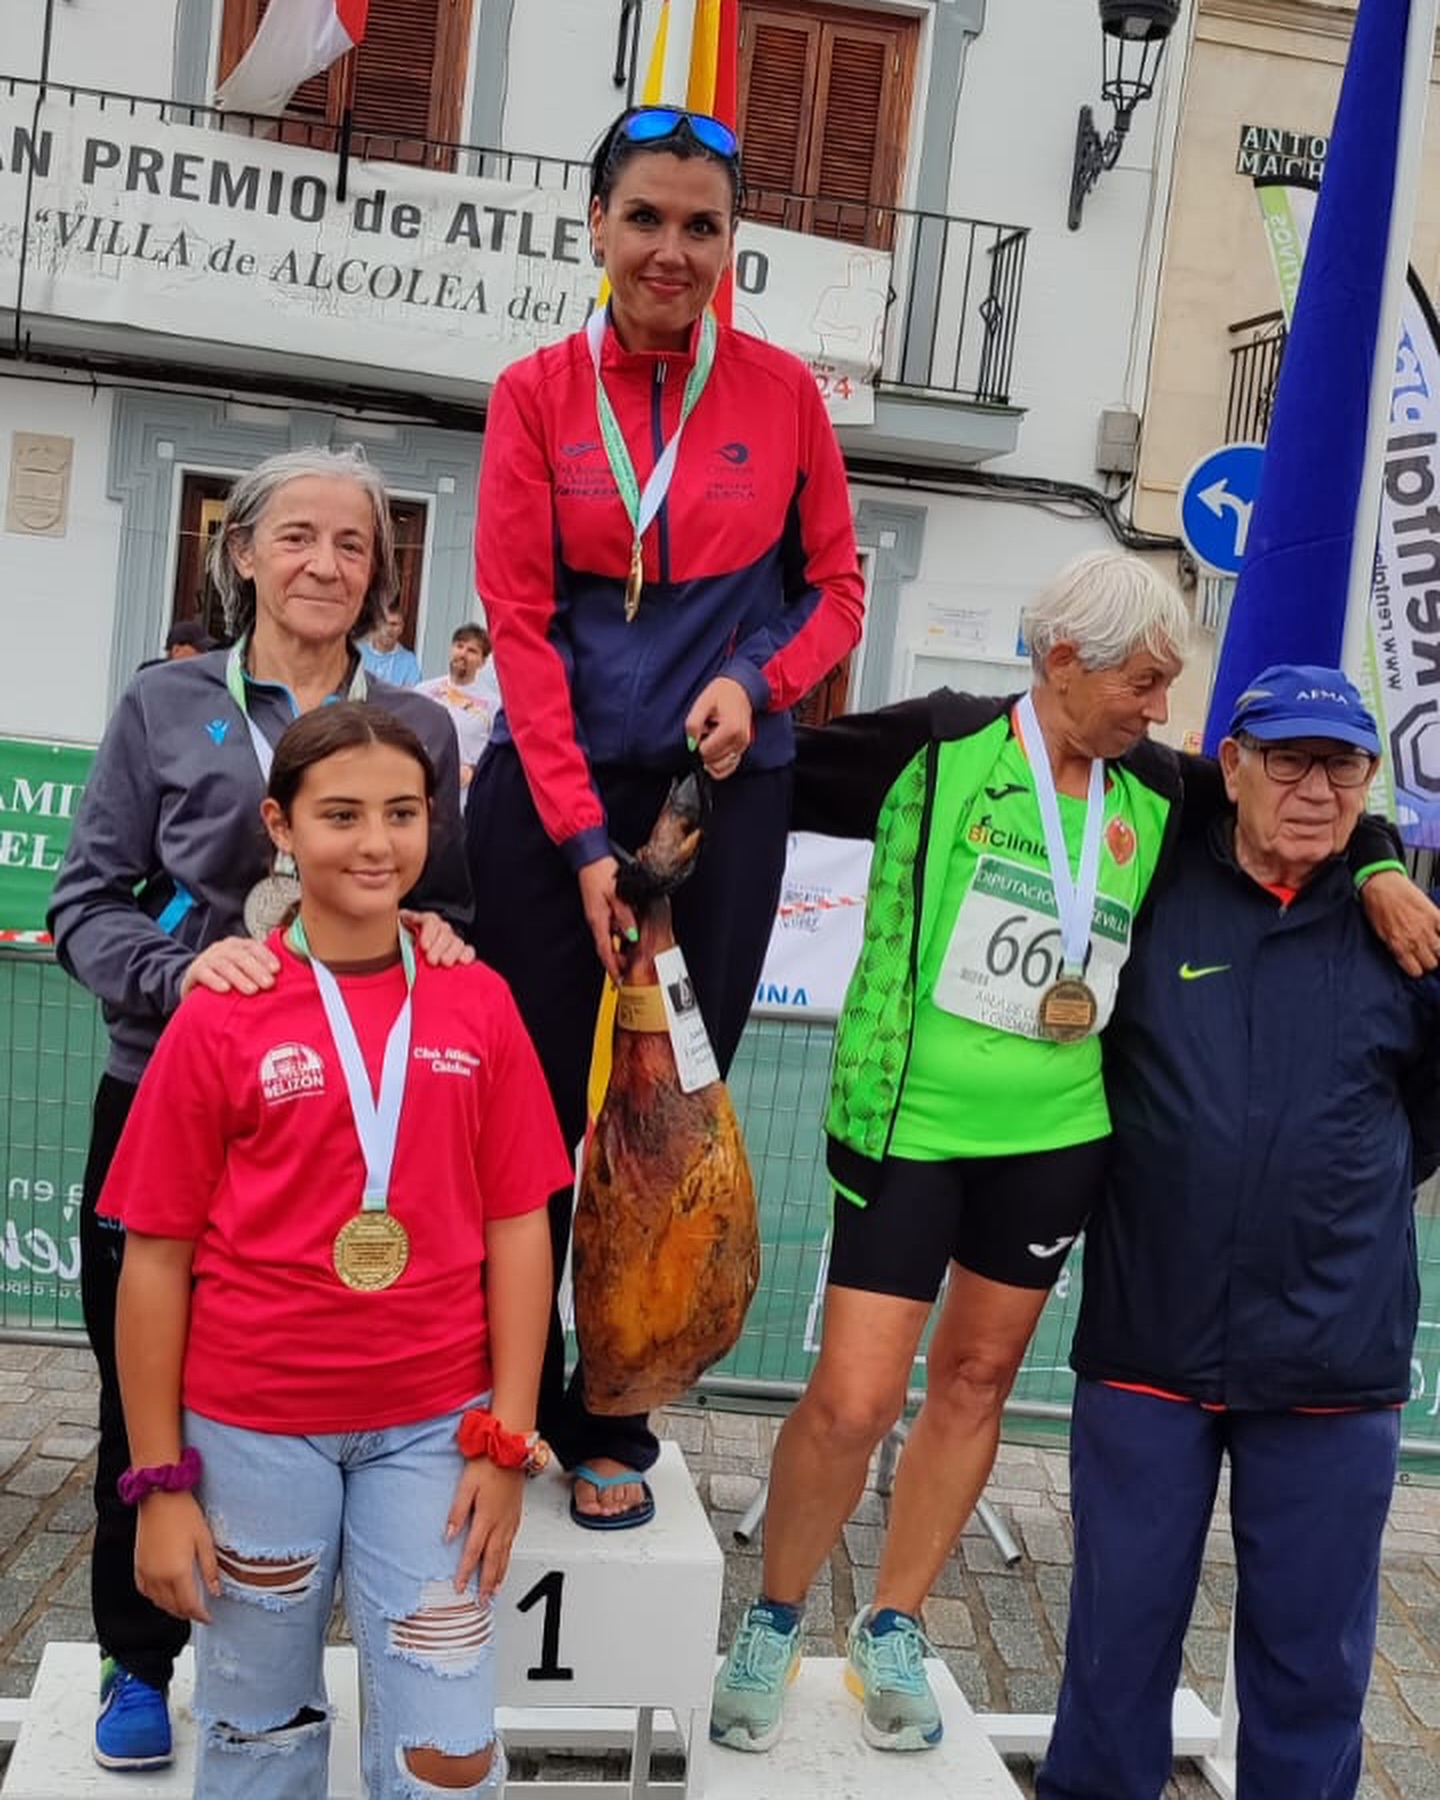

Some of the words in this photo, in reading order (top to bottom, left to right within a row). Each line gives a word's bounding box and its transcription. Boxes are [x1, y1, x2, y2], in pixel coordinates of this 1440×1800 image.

[82, 138, 327, 223] PREMIO
[352, 189, 423, 240] de
[207, 238, 256, 275] de
[269, 249, 488, 315] ALCOLEA
[507, 286, 567, 325] del
[516, 1569, 574, 1681] 1
